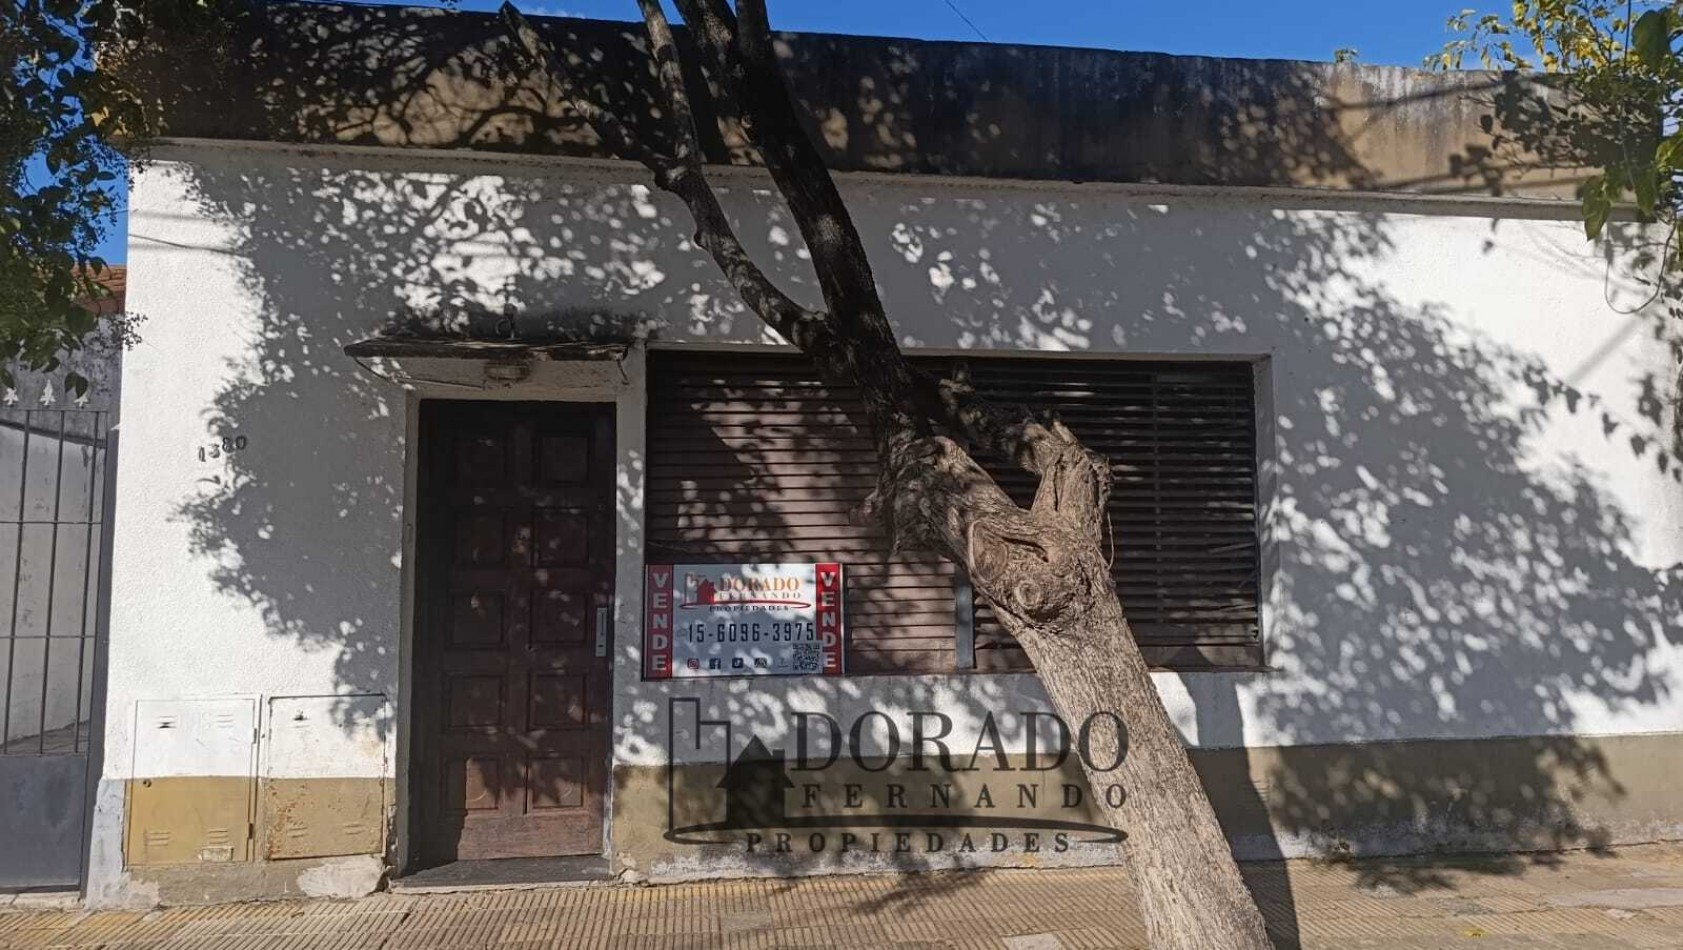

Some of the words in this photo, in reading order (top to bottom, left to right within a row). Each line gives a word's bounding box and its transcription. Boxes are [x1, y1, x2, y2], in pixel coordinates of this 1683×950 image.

[719, 576, 800, 592] DORADO
[652, 572, 669, 671] VENDE
[688, 622, 814, 643] 15-6096-3975
[820, 571, 837, 668] VENDE
